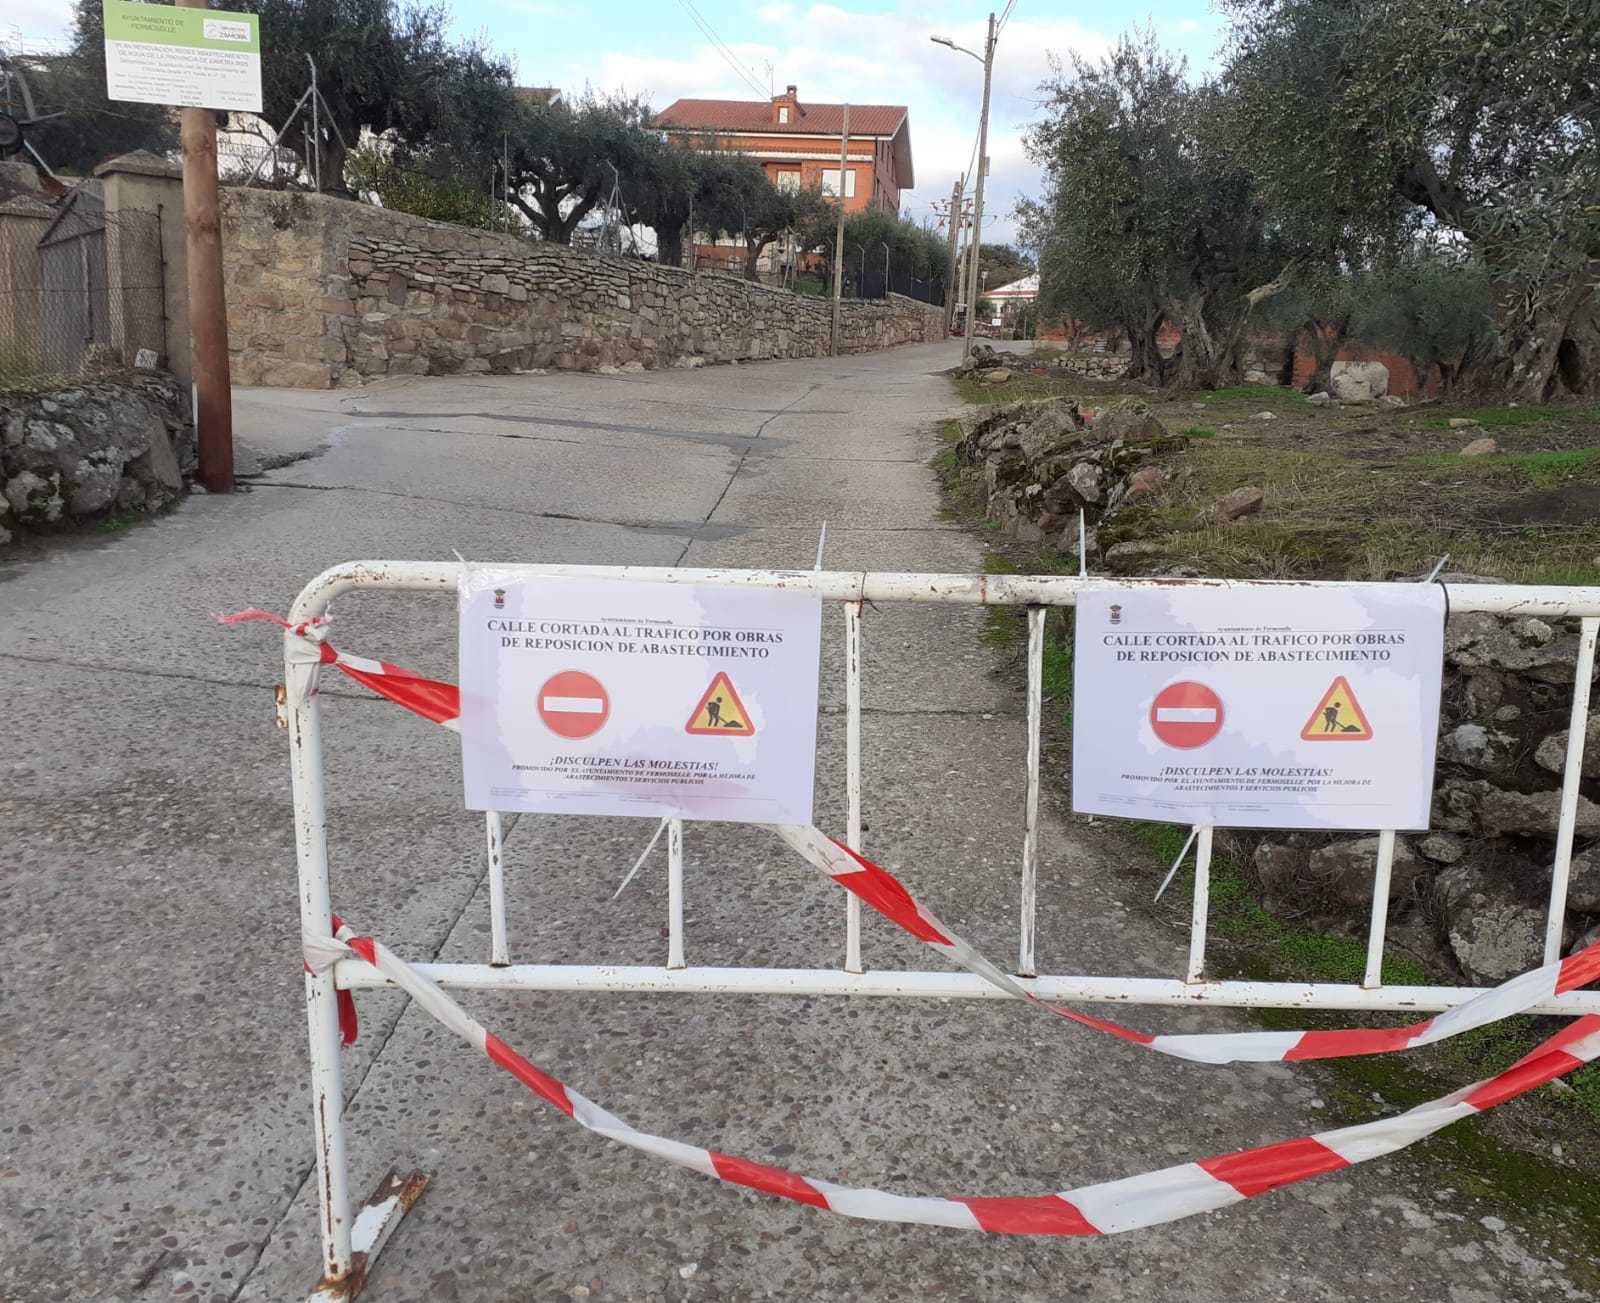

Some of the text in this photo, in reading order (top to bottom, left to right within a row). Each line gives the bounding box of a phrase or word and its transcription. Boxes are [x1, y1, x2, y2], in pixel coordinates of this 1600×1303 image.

[122, 15, 174, 25] AYUNTAMIENTO
[219, 32, 248, 40] ZAMORA
[487, 619, 784, 643] CALLE CORTADA AL TRAFICO POR OBRAS
[1103, 633, 1405, 646] CALLE CORTADA AL TRAFICO POR OBRAS
[501, 636, 769, 659] DE REPOSICION DE ABASTECIMIENTO
[1117, 650, 1391, 662] DE REPOSICION DE ABASTECIMIENTO
[550, 756, 719, 771] ¡DISCULPEN LAS MOLESTIAS!
[1160, 766, 1334, 777] ¡DISCULPEN LAS MOLESTIAS!
